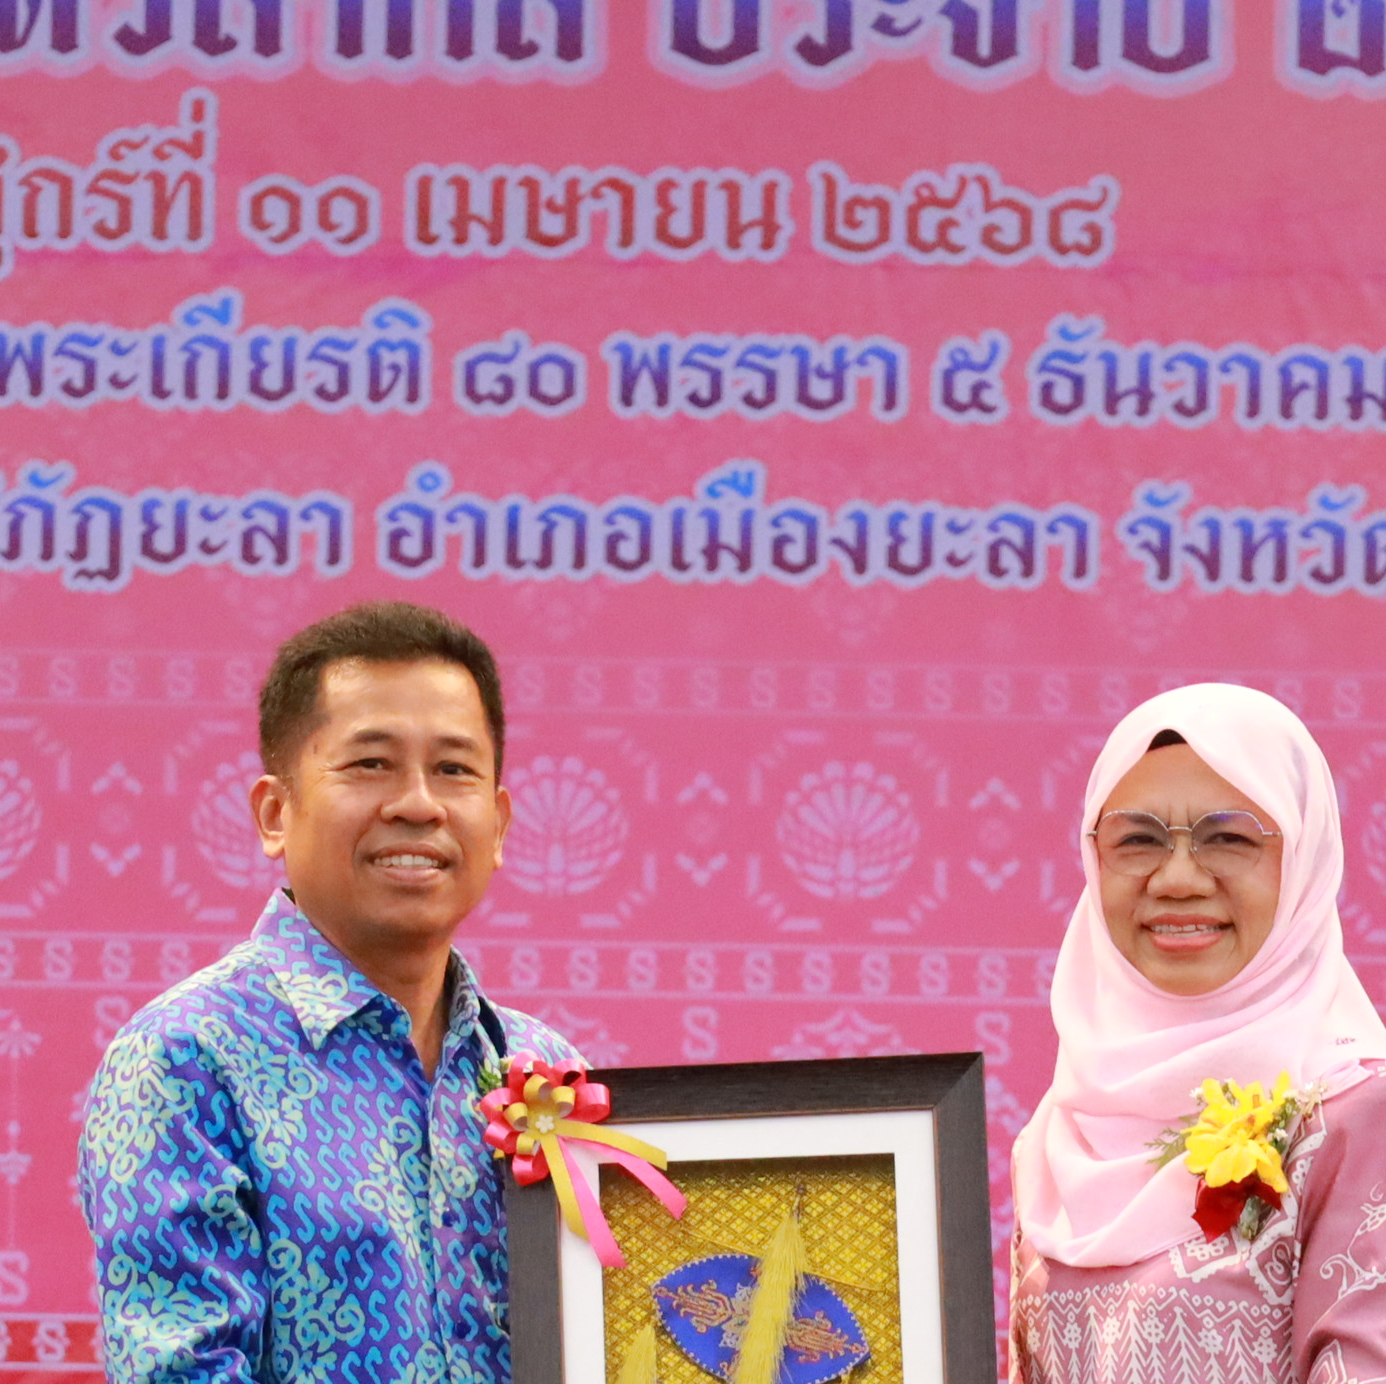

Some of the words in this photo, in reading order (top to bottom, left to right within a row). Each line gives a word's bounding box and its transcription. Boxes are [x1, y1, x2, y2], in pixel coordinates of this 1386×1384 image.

[248, 186, 369, 245] ๑๑
[415, 174, 781, 250] เมษายน
[819, 172, 1109, 256] ๒๕๖๘
[462, 338, 578, 408] ๘๐
[610, 339, 900, 413] พรรษา
[940, 339, 1002, 415] ๕
[384, 469, 1090, 579] อำเภอเมืองยะลา
